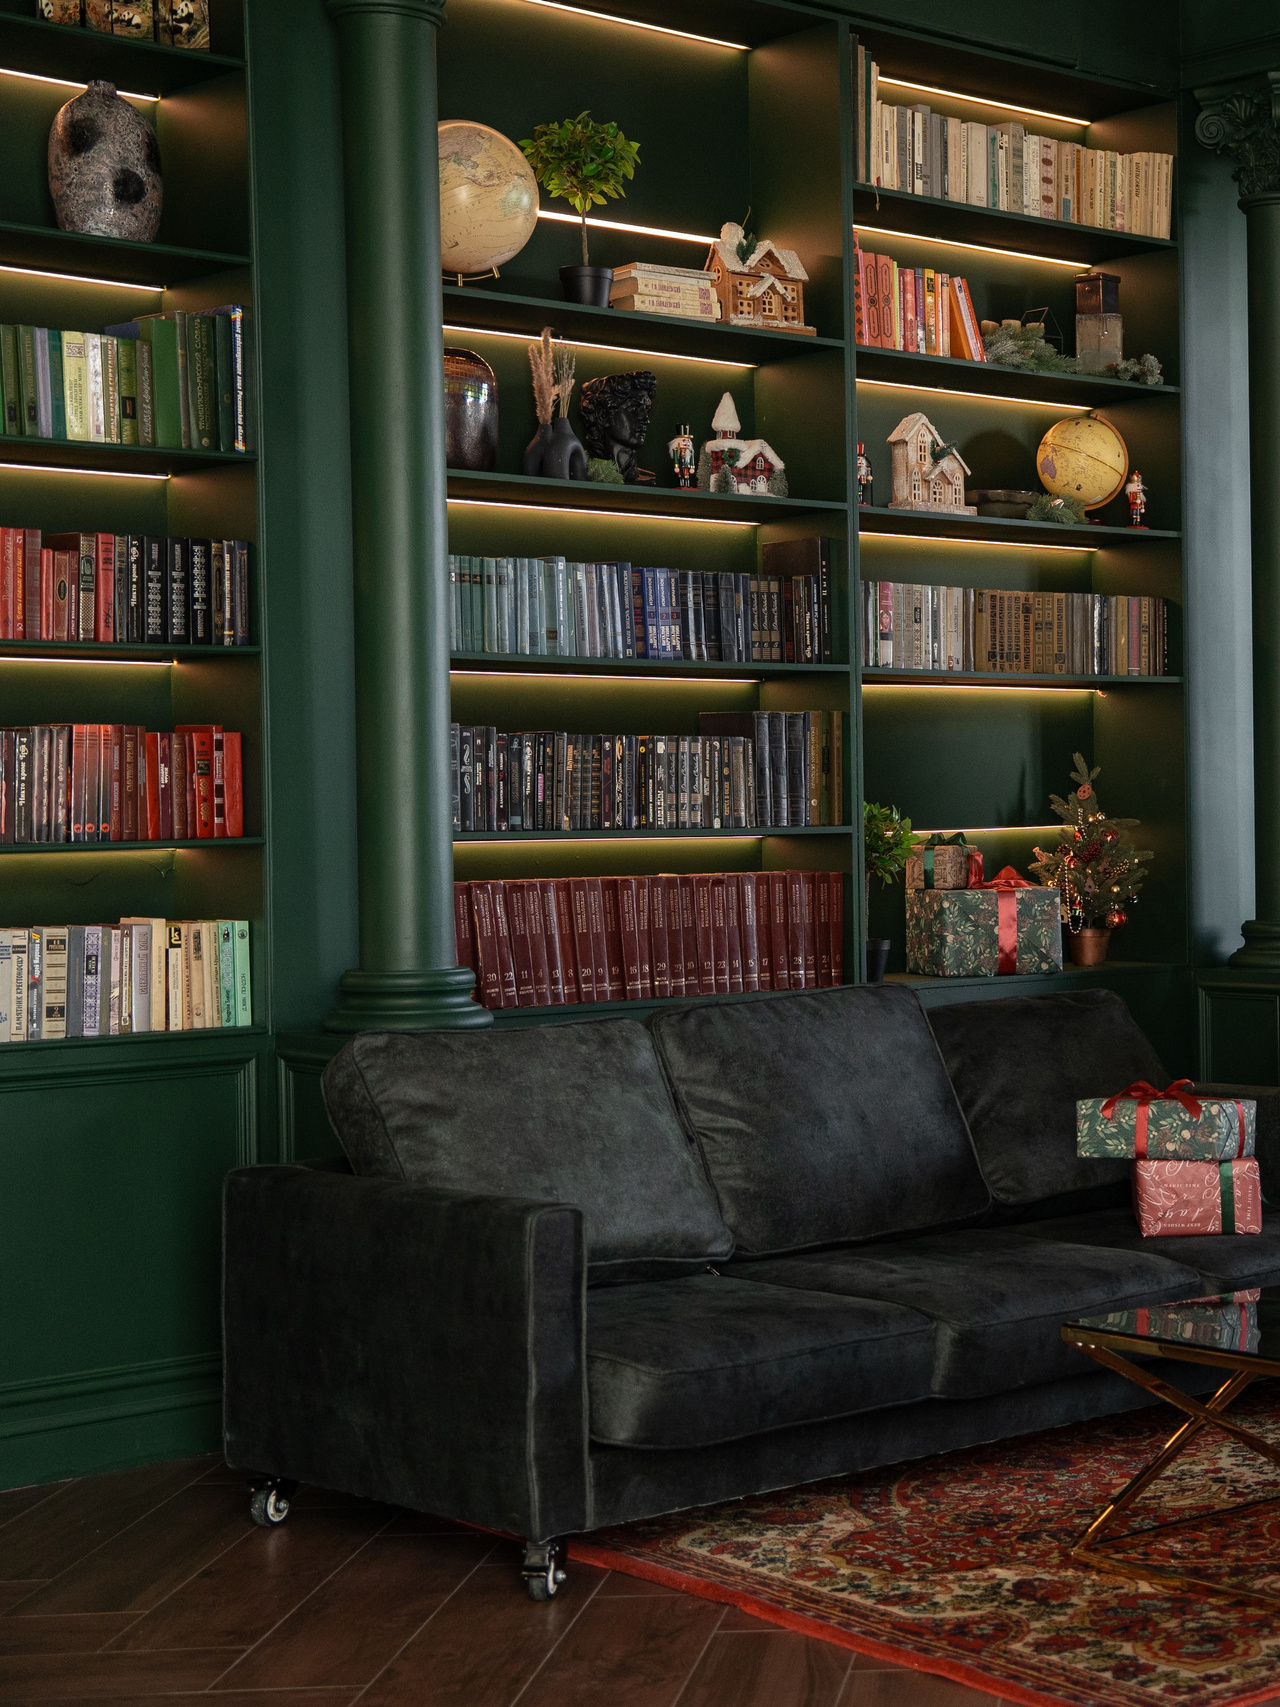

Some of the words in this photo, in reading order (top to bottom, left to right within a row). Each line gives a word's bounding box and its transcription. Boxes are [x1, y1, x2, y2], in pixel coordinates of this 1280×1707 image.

[762, 958, 768, 966] 17
[794, 957, 802, 965] 28
[807, 956, 815, 964] 25
[582, 968, 591, 976] 20
[598, 968, 603, 976] 9
[612, 967, 619, 975] 19
[630, 966, 637, 974] 16
[642, 964, 649, 972] 18
[504, 972, 513, 980] 22
[522, 971, 528, 979] 11
[538, 969, 543, 977] 4
[552, 970, 559, 978] 13
[568, 969, 573, 977] 8
[487, 974, 496, 982] 30
